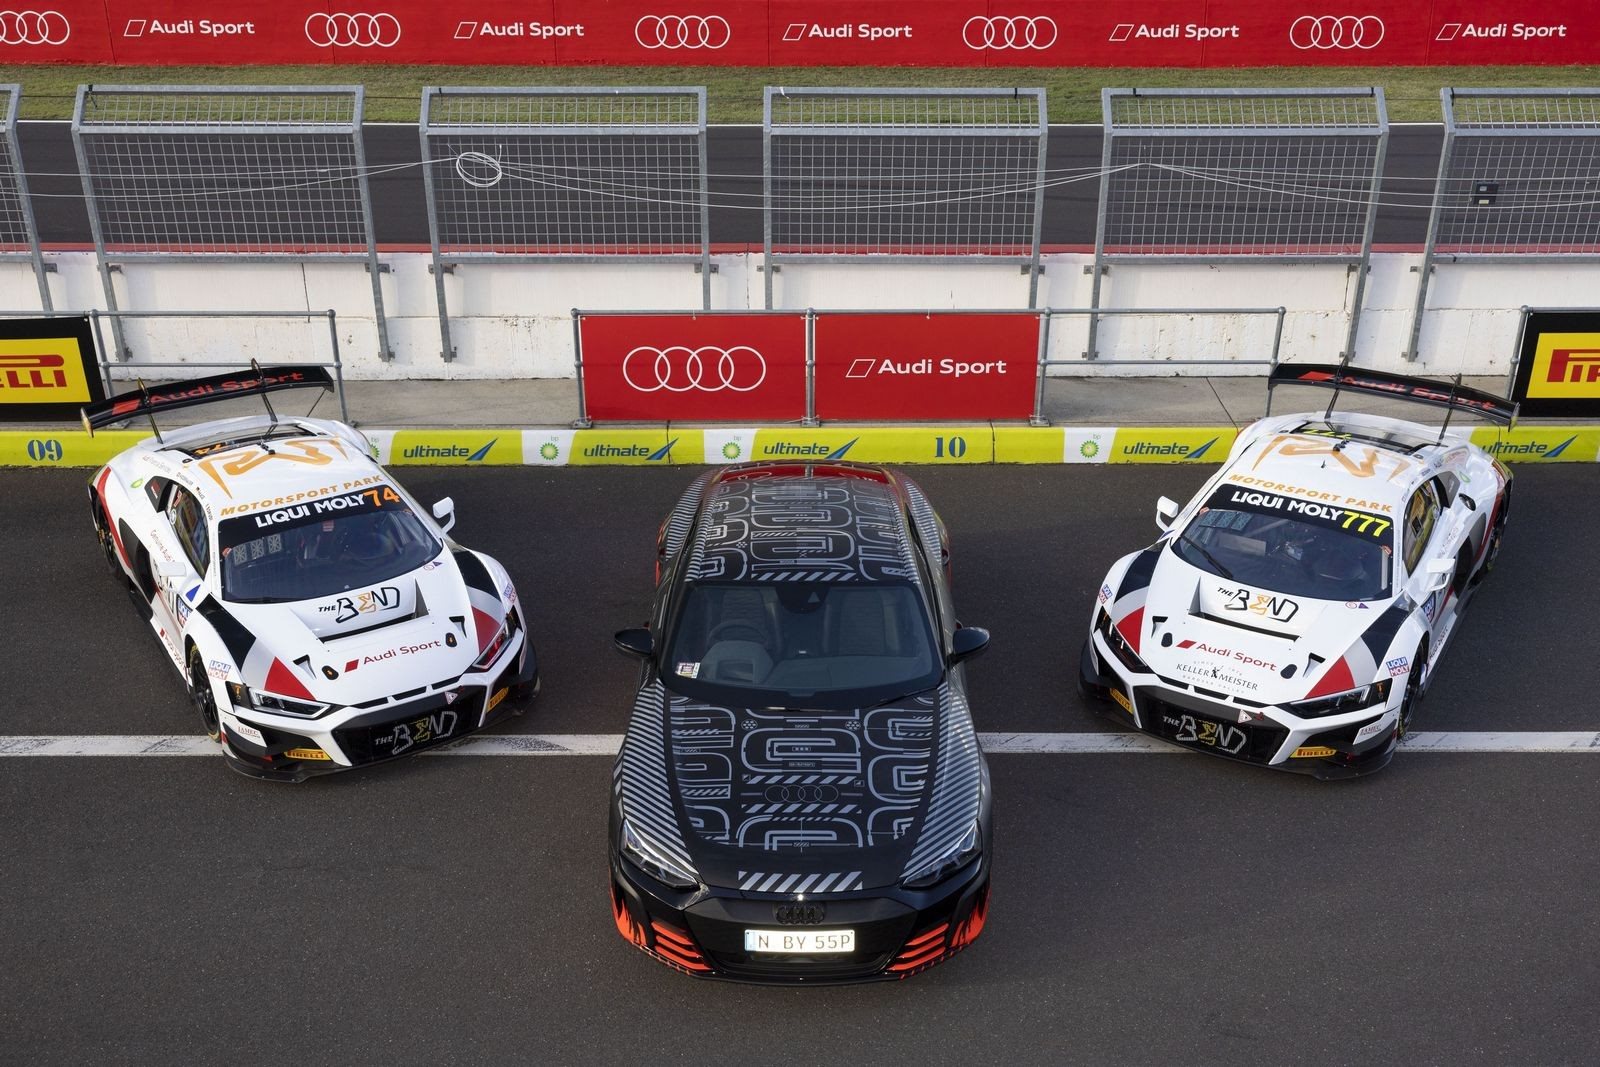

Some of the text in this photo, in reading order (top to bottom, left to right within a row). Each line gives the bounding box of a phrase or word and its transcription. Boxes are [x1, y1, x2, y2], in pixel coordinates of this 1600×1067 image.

[150, 20, 254, 36] Audi Sport
[480, 22, 584, 39] Audi Sport
[808, 24, 912, 40] Audi Sport
[1136, 24, 1239, 40] Audi Sport
[1462, 23, 1566, 40] Audi Sport
[878, 359, 1006, 377] Audi Sport
[151, 371, 304, 405] Audi Sport
[27, 439, 63, 461] 09
[404, 444, 469, 458] ultimate
[584, 444, 649, 457] ultimate
[764, 444, 829, 457] ultimate
[934, 436, 966, 458] 10
[1123, 441, 1189, 456] ultimate
[220, 484, 338, 517] MOTORSPORT
[343, 474, 383, 490] PARK
[363, 487, 401, 507] 74
[1228, 474, 1393, 513] MOTORSPORT PARK
[255, 494, 366, 528] LIQUI MOLY
[1231, 490, 1345, 521] LIQUI MOLY
[1341, 510, 1391, 538] 777
[1217, 587, 1234, 597] THE
[318, 604, 337, 613] THE
[363, 640, 442, 665] Audi Sport
[1196, 643, 1231, 657] Audi
[1233, 652, 1277, 671] Sport
[209, 659, 232, 672] LIQUI
[1387, 657, 1408, 669] LIQUI
[1176, 663, 1209, 677] KELLER
[1218, 673, 1258, 691] MEISTER
[1389, 666, 1410, 677] MOLY
[287, 749, 325, 759] PIRELLI
[1296, 748, 1335, 757] PIRELLI
[758, 934, 851, 950] N BY 55P
